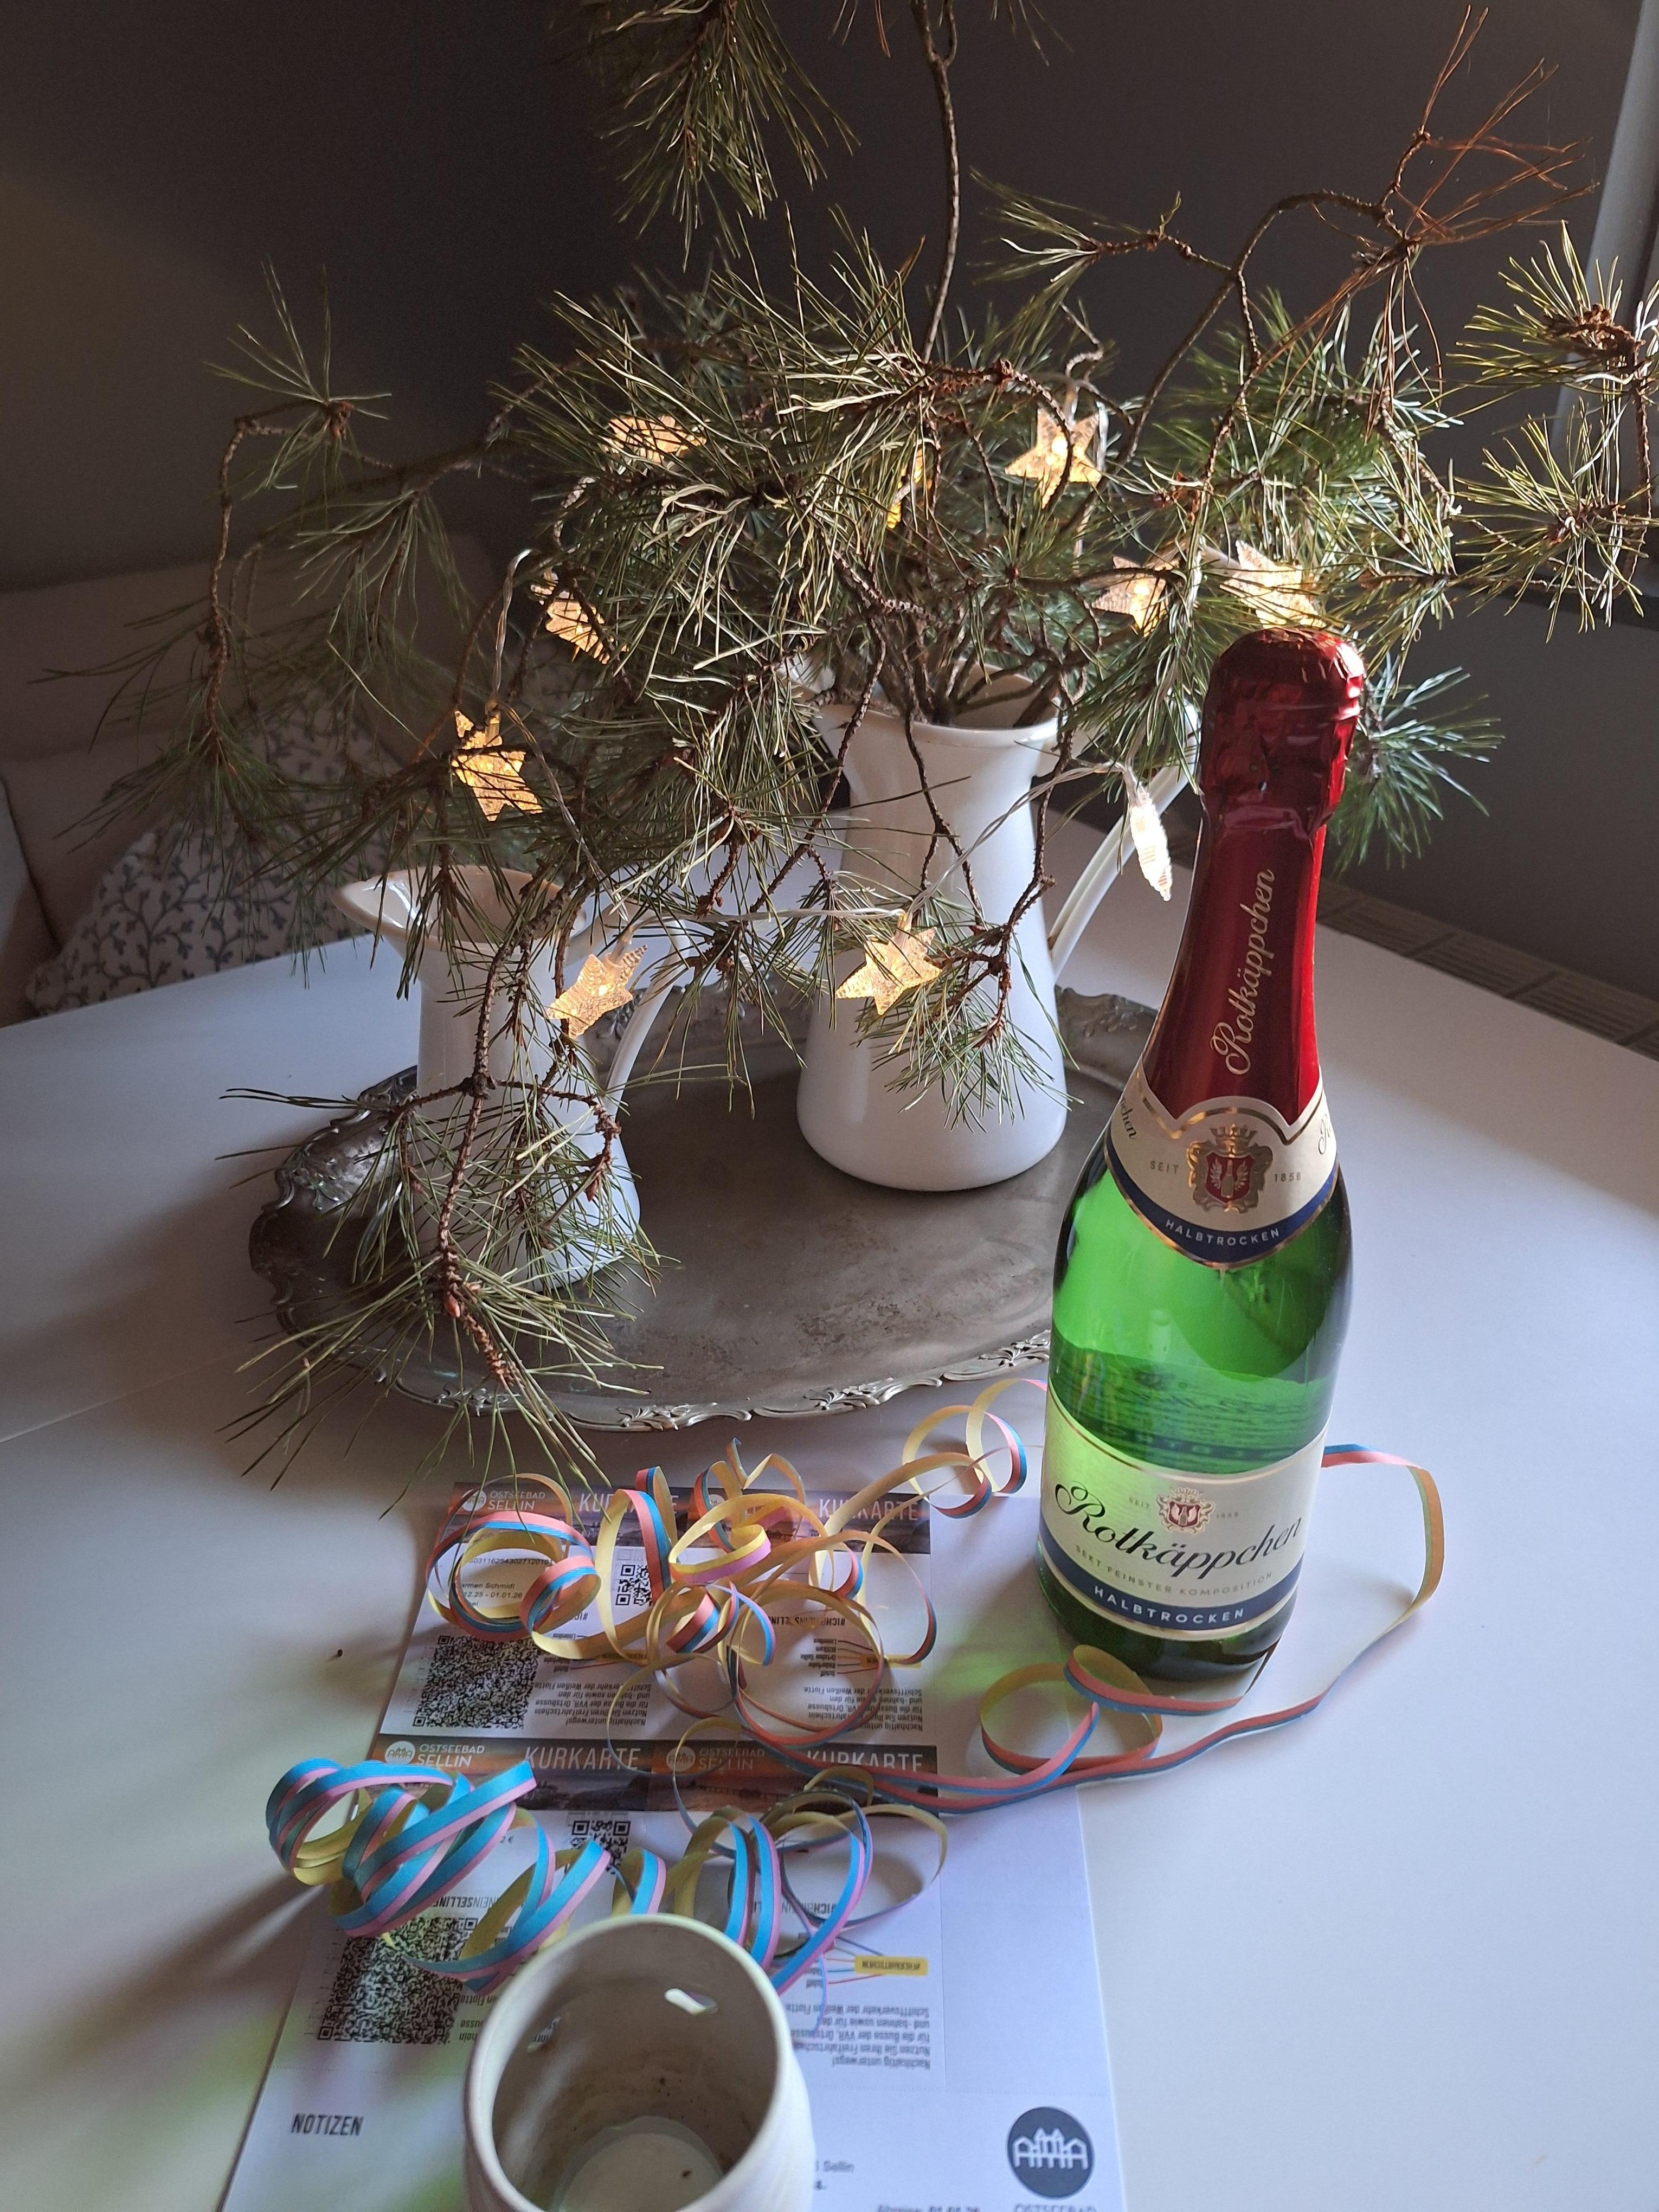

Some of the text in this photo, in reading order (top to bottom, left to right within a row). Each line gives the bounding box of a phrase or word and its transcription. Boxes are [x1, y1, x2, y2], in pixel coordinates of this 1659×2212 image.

[1210, 869, 1275, 1076] Rotkäppchen
[1150, 1161, 1179, 1174] SEIT
[1165, 1219, 1280, 1246] HALBTROCKEN
[490, 1490, 545, 1500] OSTSEEBAD
[487, 1500, 535, 1511] SELLIN
[1054, 1480, 1302, 1580] Rotkäppchen
[1076, 1545, 1272, 1596] SEKT FEINSTER KOMPOSITION
[1094, 1585, 1245, 1624] HALBTROCKEN
[536, 1699, 570, 1707] Ortsbusse
[845, 1696, 854, 1704] für
[808, 1702, 844, 1712] Ortsbusse
[913, 1705, 922, 1713] für
[535, 1708, 590, 1717] Freifahrtschein
[623, 1709, 647, 1717] Nutzen
[885, 1714, 895, 1722] Sie
[896, 1714, 923, 1723] Nutzen
[885, 1721, 923, 1731] Nachhaltig
[420, 1743, 485, 1754] OSTSEEBAD
[417, 1754, 473, 1768] SELLIN
[524, 1746, 641, 1770] KURKARTE
[847, 2005, 860, 2015] der
[834, 2018, 847, 2027] für
[914, 2020, 929, 2029] und
[858, 2030, 872, 2040] der
[874, 2031, 900, 2043] Busse
[902, 2033, 915, 2041] die
[917, 2033, 929, 2043] für
[860, 2044, 883, 2055] Ihren
[885, 2045, 897, 2056] Sie
[900, 2046, 930, 2057] Nutzen
[832, 2055, 931, 2070] Nachhaltig unterwegs!
[291, 2113, 365, 2137] NOTIZEN
